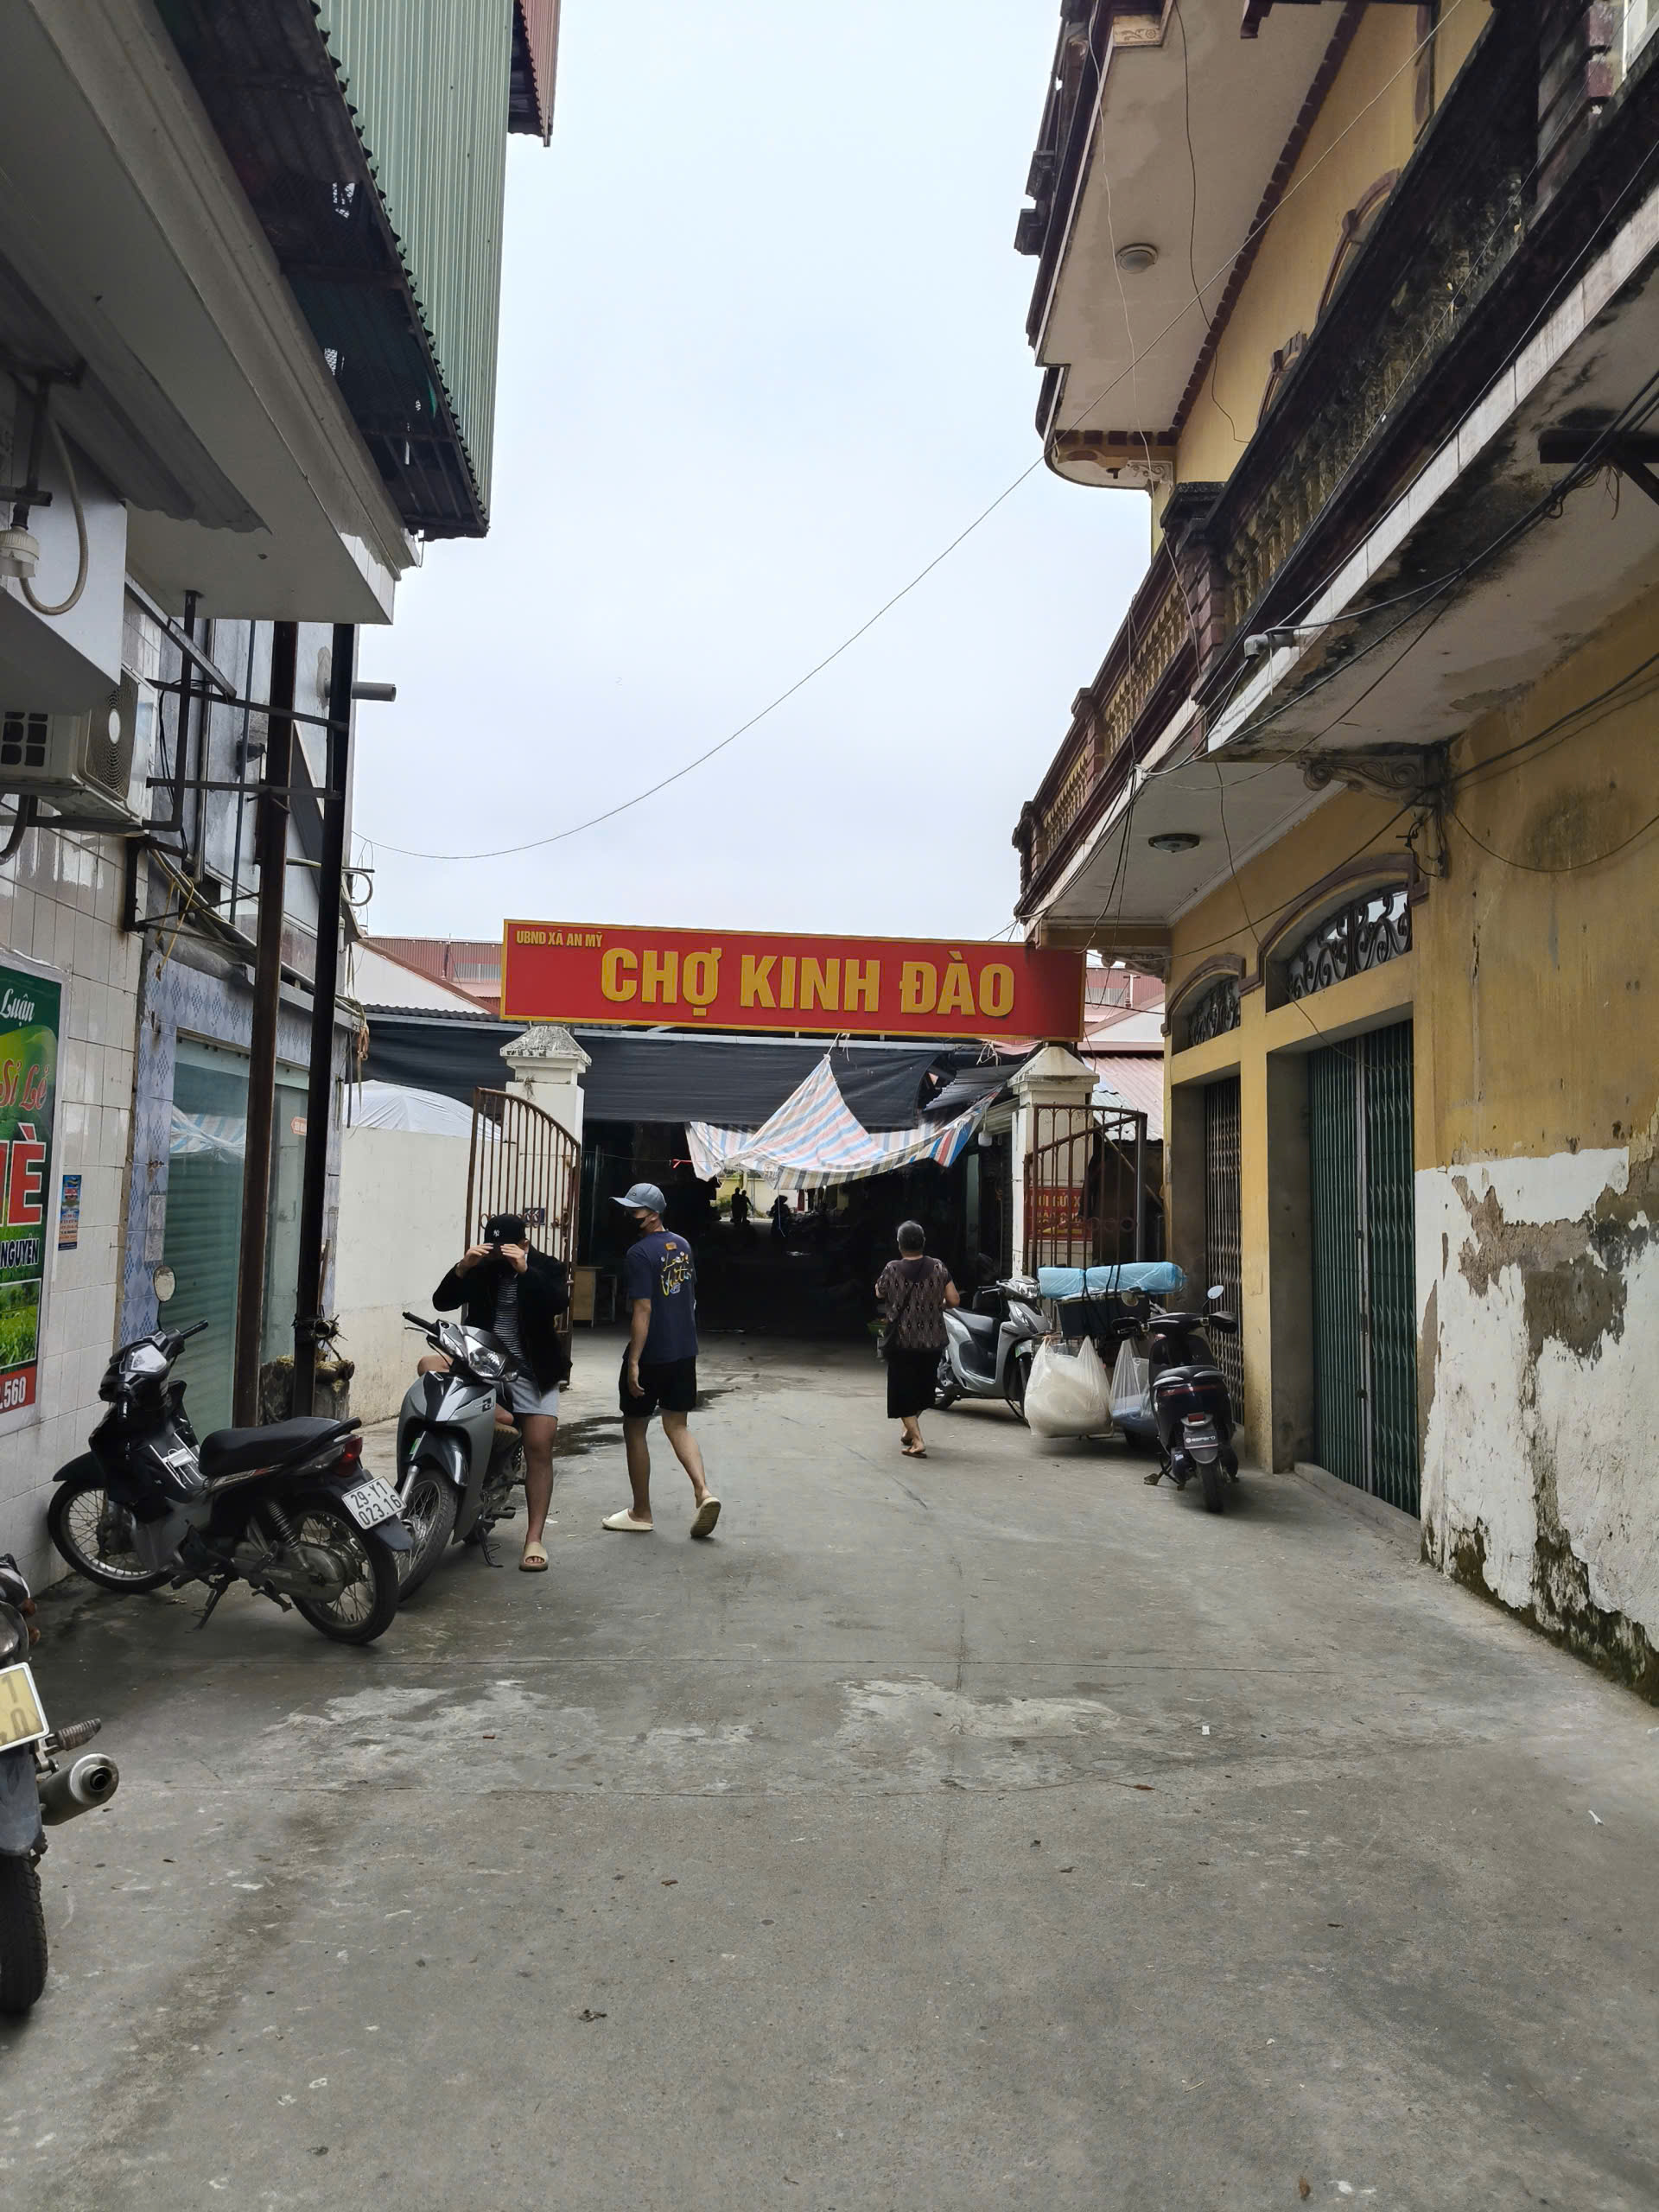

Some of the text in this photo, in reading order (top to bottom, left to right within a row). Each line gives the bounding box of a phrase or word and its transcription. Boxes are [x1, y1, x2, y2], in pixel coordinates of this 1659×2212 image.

[516, 931, 546, 944] UBND
[548, 930, 563, 945] XÃ
[566, 932, 582, 947] AN
[601, 947, 1014, 1018] CHỢ KINH ĐÀO
[0, 988, 35, 1027] Luận
[359, 1495, 402, 1525] 023.16
